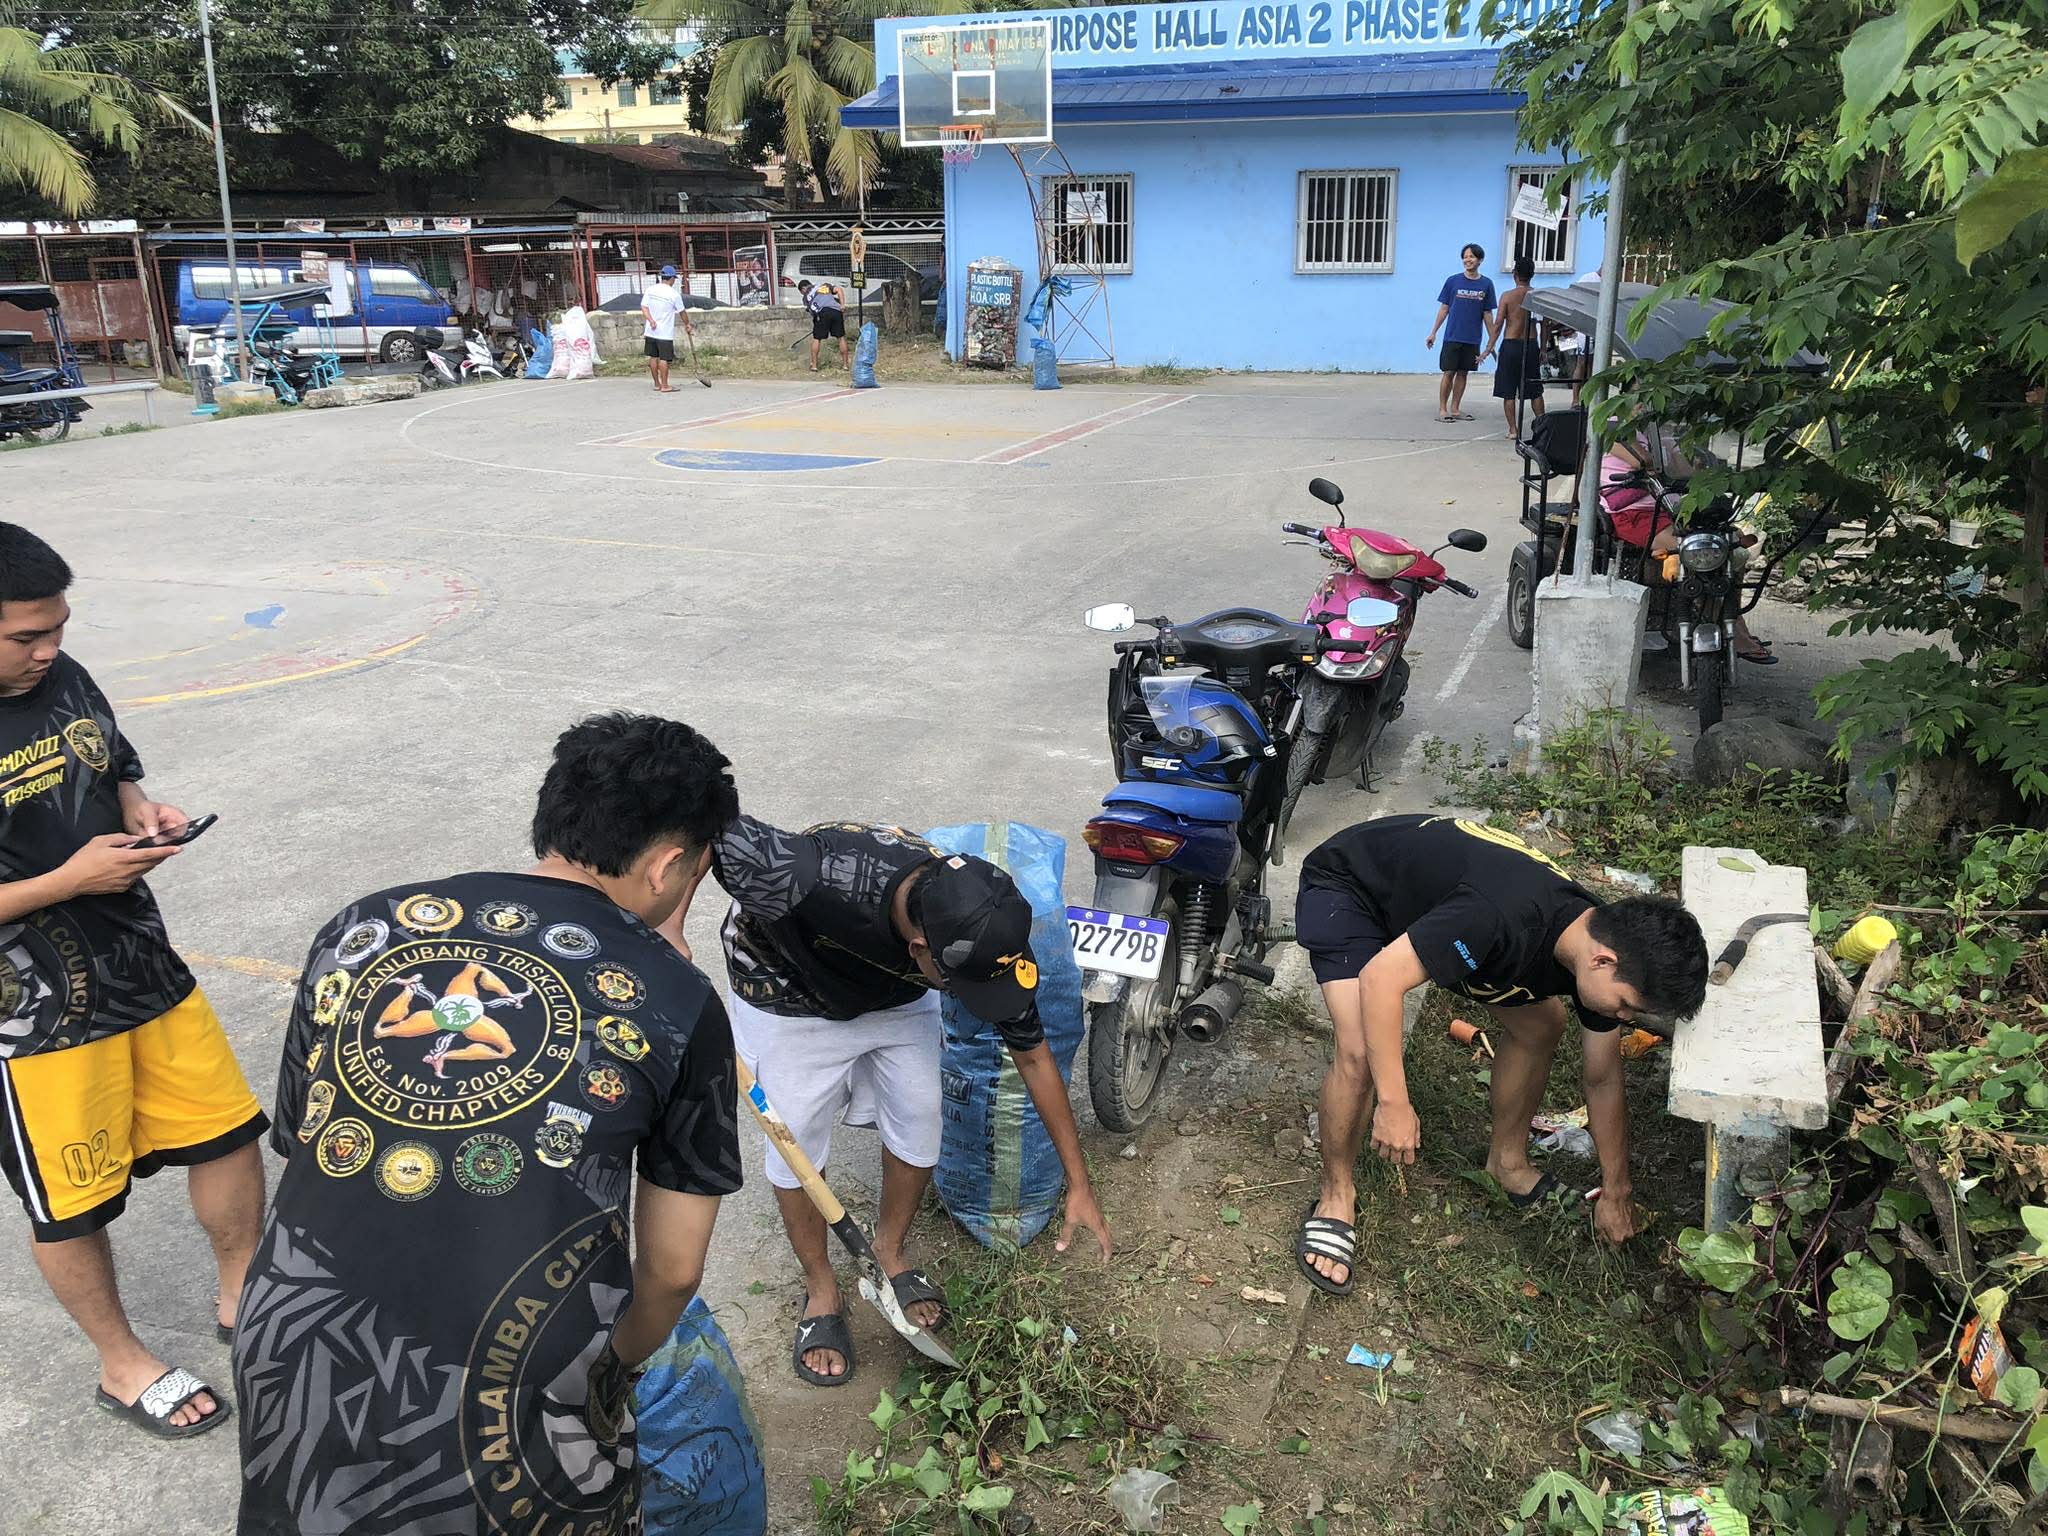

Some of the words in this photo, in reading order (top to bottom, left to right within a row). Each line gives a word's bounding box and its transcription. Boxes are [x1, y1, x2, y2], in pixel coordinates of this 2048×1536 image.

[1032, 10, 1137, 51] URPOSE
[1155, 8, 1228, 49] HALL
[1238, 4, 1301, 46] ASIA
[1308, 2, 1332, 44] 2
[1345, 0, 1439, 42] PHASE
[971, 273, 992, 285] PLASTIC
[992, 275, 1013, 287] BOTTLE
[993, 292, 1012, 306] SRB
[1141, 755, 1182, 771] SEC
[49, 926, 89, 1026] COUNCIL
[357, 945, 489, 1000] CANLUBANG
[493, 951, 574, 1036] TRISKELION
[343, 1009, 362, 1025] 19
[366, 1045, 392, 1080] Est.
[398, 1074, 447, 1097] Nov.
[455, 1064, 512, 1096] 2009
[547, 1044, 571, 1060] 68
[342, 1040, 401, 1113] UNIFIED
[408, 1067, 545, 1121] CHAPTERS
[62, 1129, 122, 1187] 02
[478, 1295, 550, 1493] CALAMBA
[544, 1229, 605, 1289] CIT
